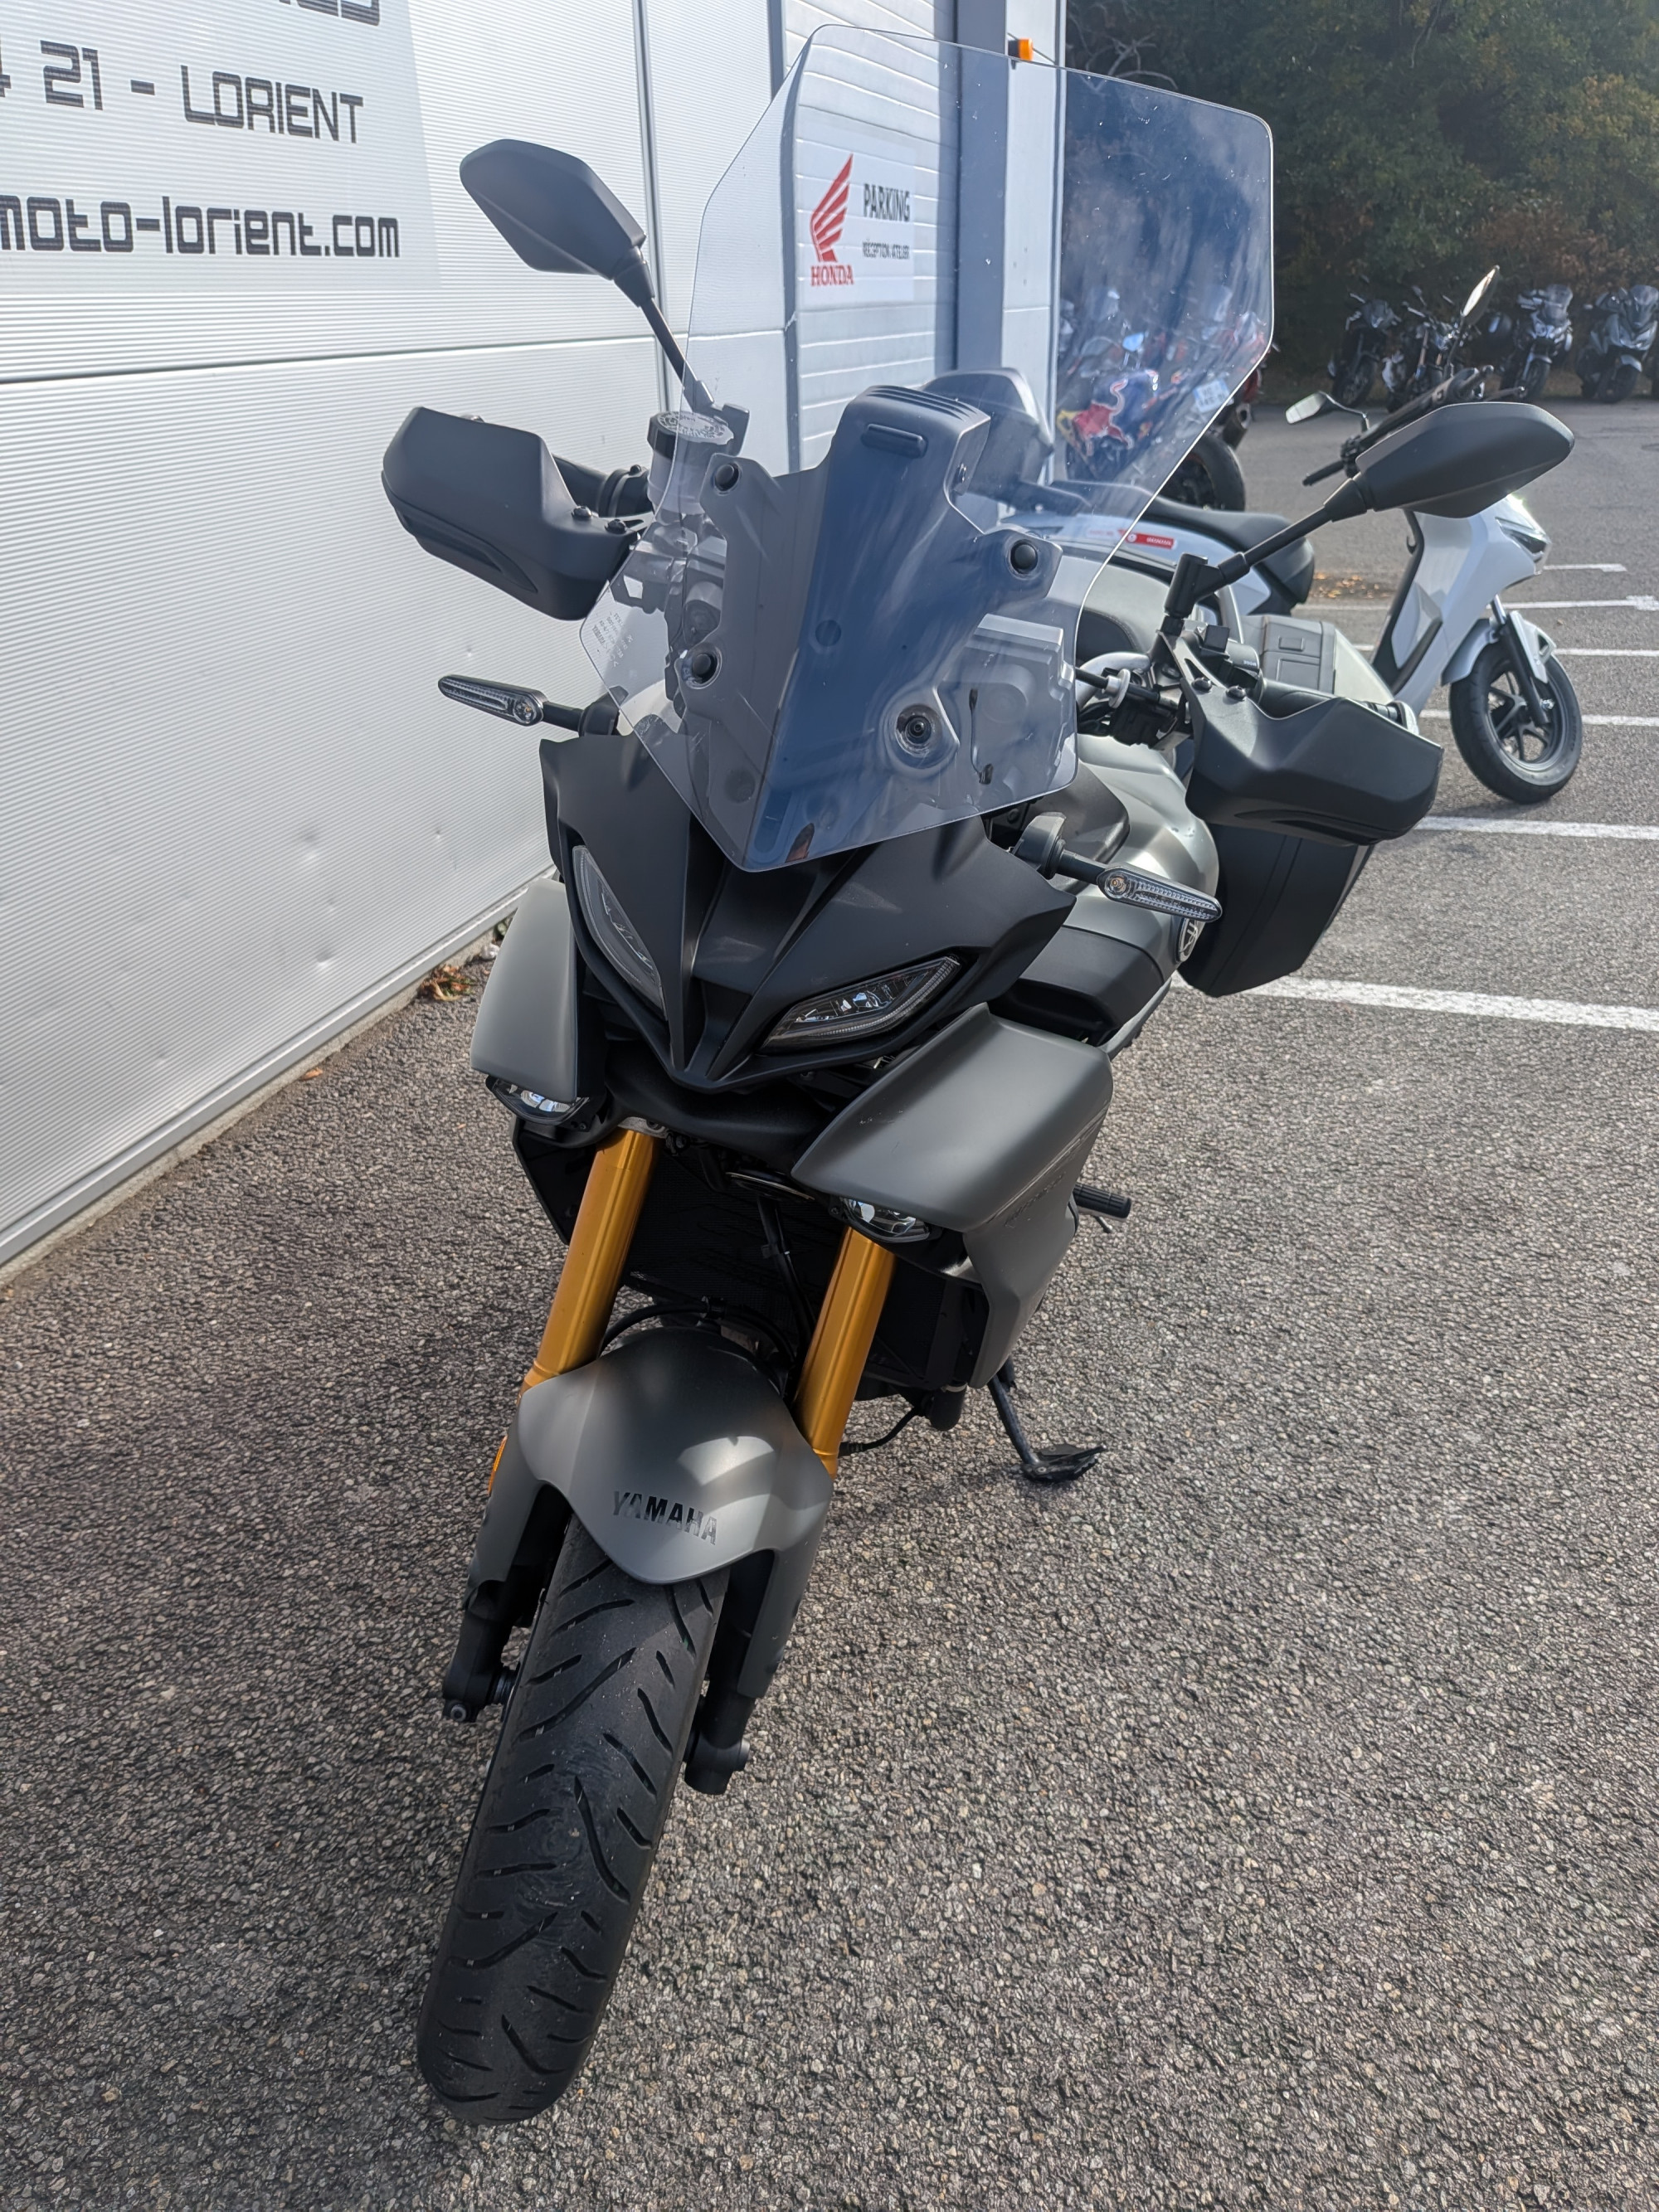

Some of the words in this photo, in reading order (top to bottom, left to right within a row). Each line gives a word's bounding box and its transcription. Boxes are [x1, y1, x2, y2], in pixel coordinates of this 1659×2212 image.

[40, 40, 103, 110] 21
[180, 65, 363, 143] LORIENT
[0, 195, 400, 258] moto-lorient.com
[863, 183, 910, 222] PARKING
[810, 265, 854, 287] HONDA
[612, 1490, 718, 1546] YAMAHA
